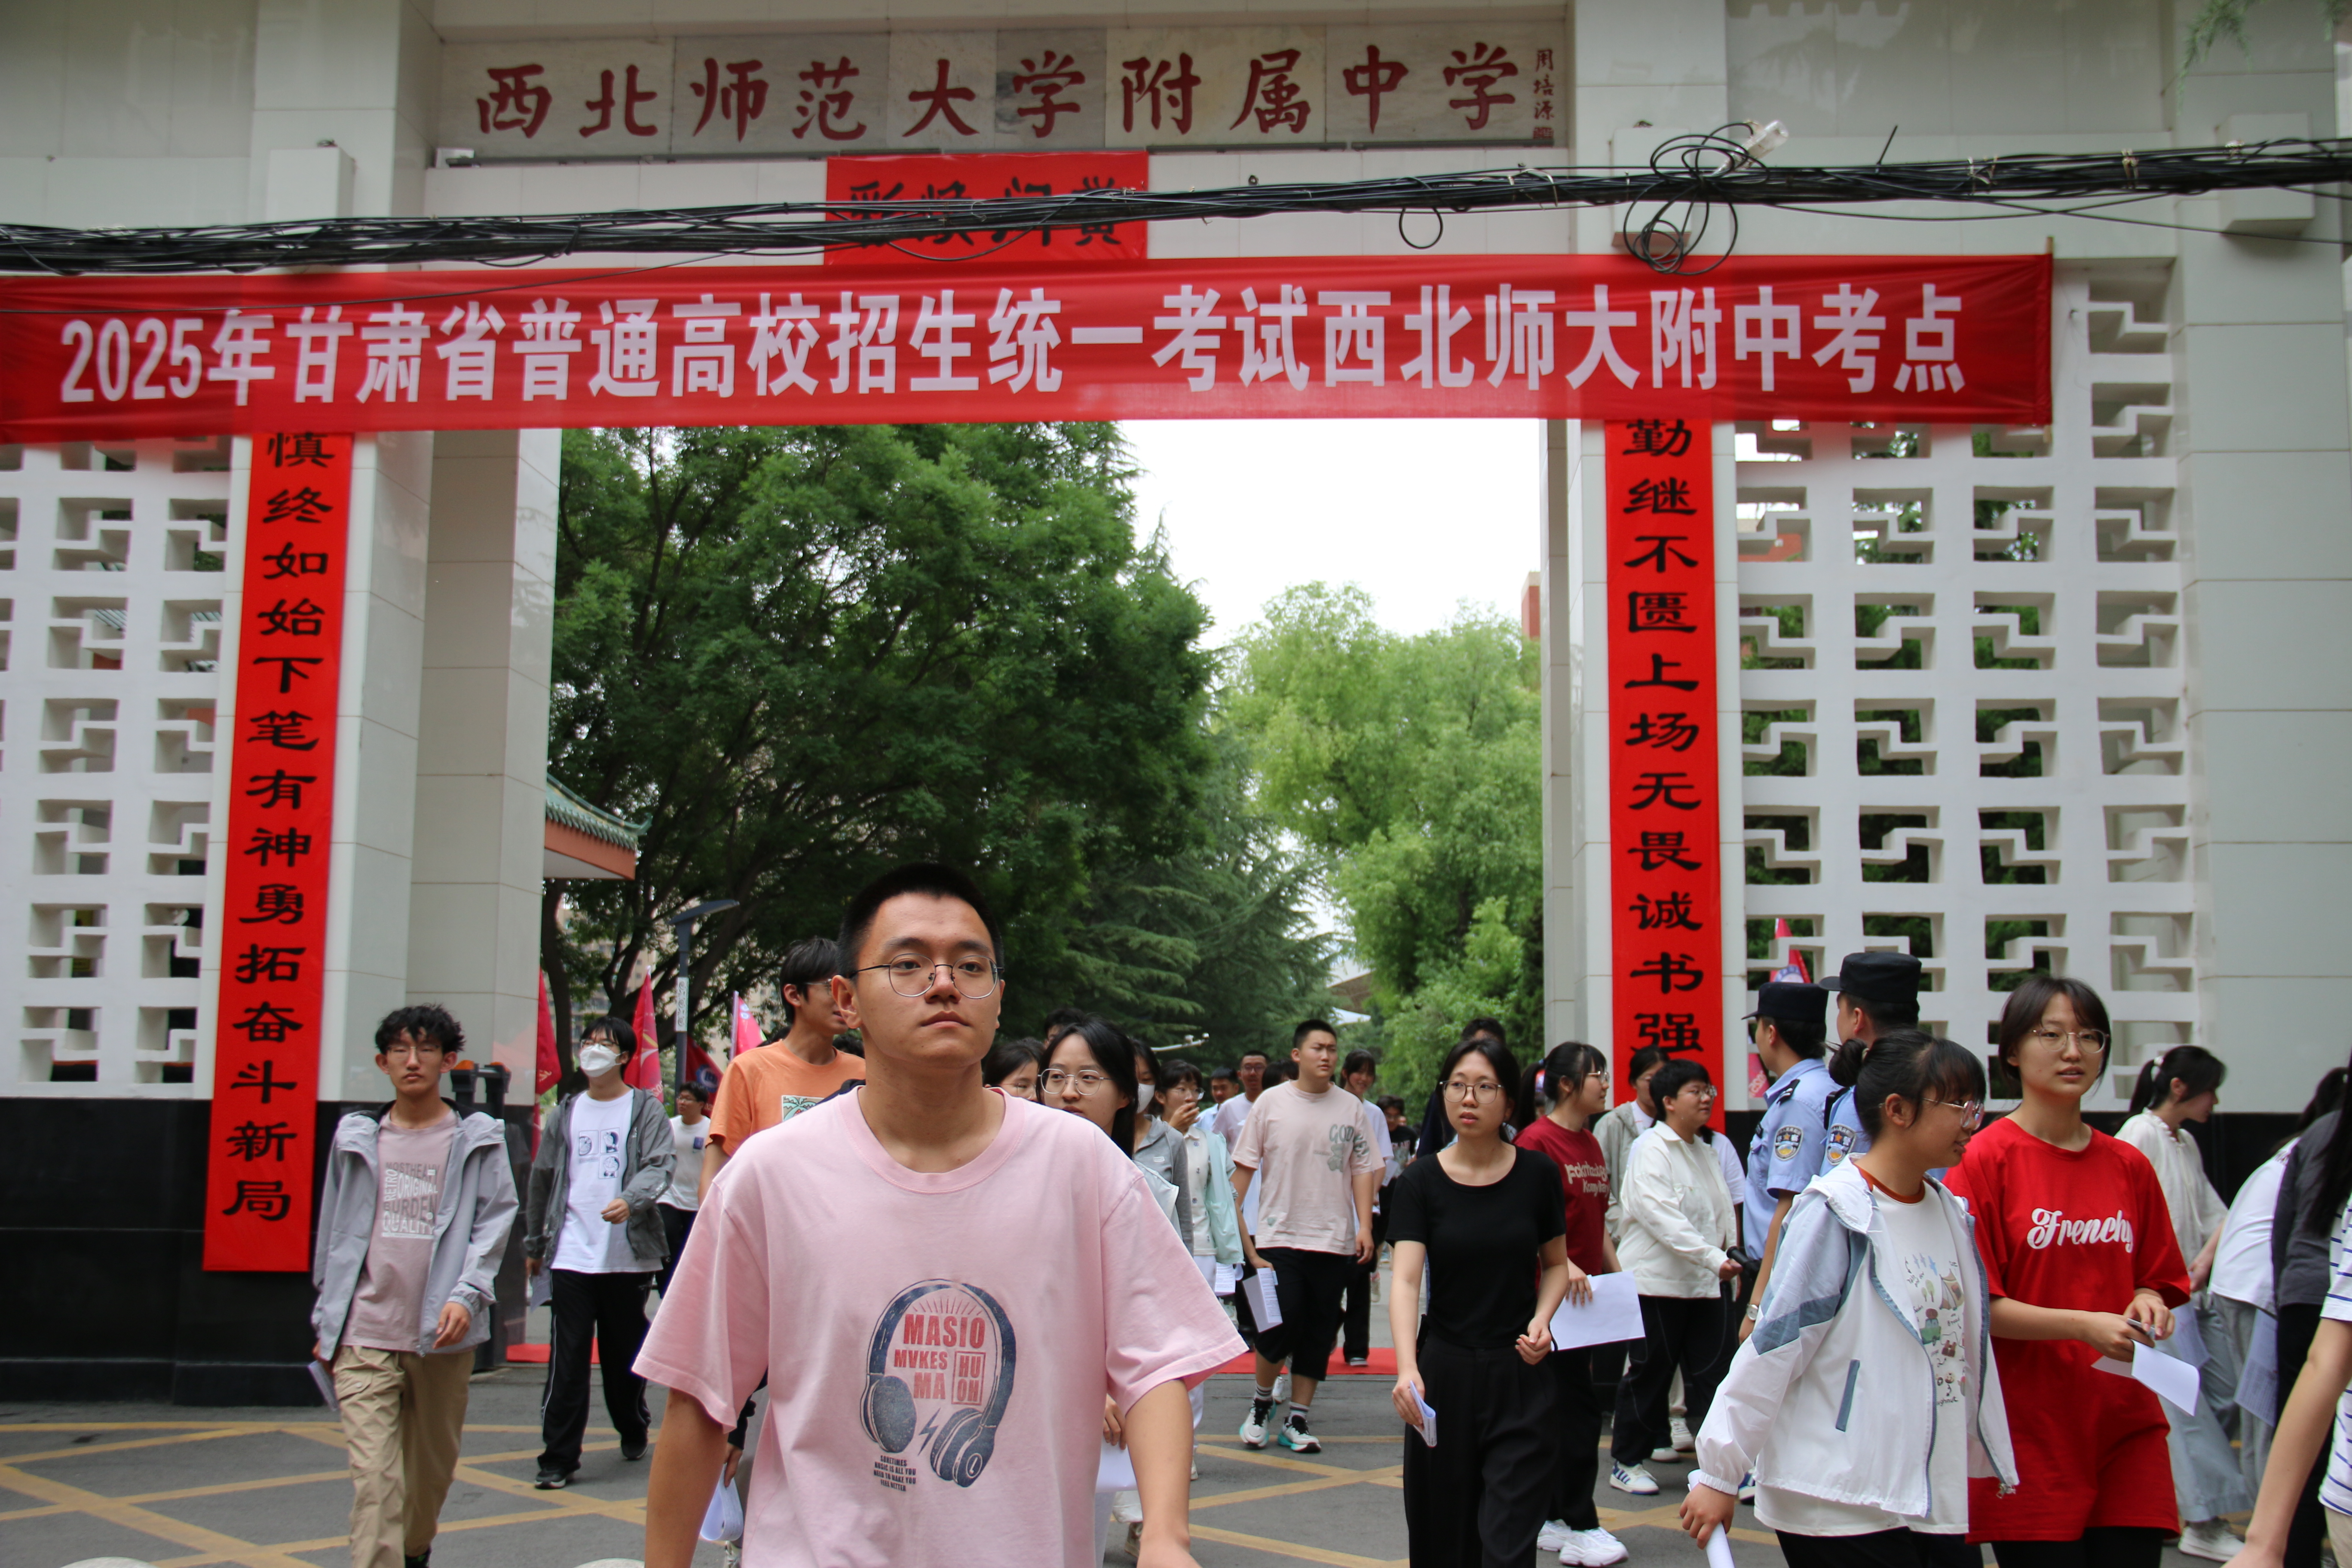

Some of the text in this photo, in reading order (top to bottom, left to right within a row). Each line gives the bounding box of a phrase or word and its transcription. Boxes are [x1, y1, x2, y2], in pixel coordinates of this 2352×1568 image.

[477, 42, 1520, 142] 西北师范大学附属中学
[61, 283, 1966, 407] 2025年甘肃省普通高校招生统一考试西北师大附中考点
[222, 431, 335, 1222] 慎终如始下笔有神勇拓奋斗新局
[385, 1169, 398, 1202] RETRO
[398, 1172, 438, 1198] ORIGINAL
[383, 1210, 435, 1234] QUALITY
[903, 1314, 986, 1349] MASIO
[959, 1355, 981, 1378] HU
[913, 1372, 946, 1400] MA
[880, 1455, 907, 1467] SOMETIMES
[889, 1464, 894, 1472] IS
[895, 1466, 904, 1474] ALL
